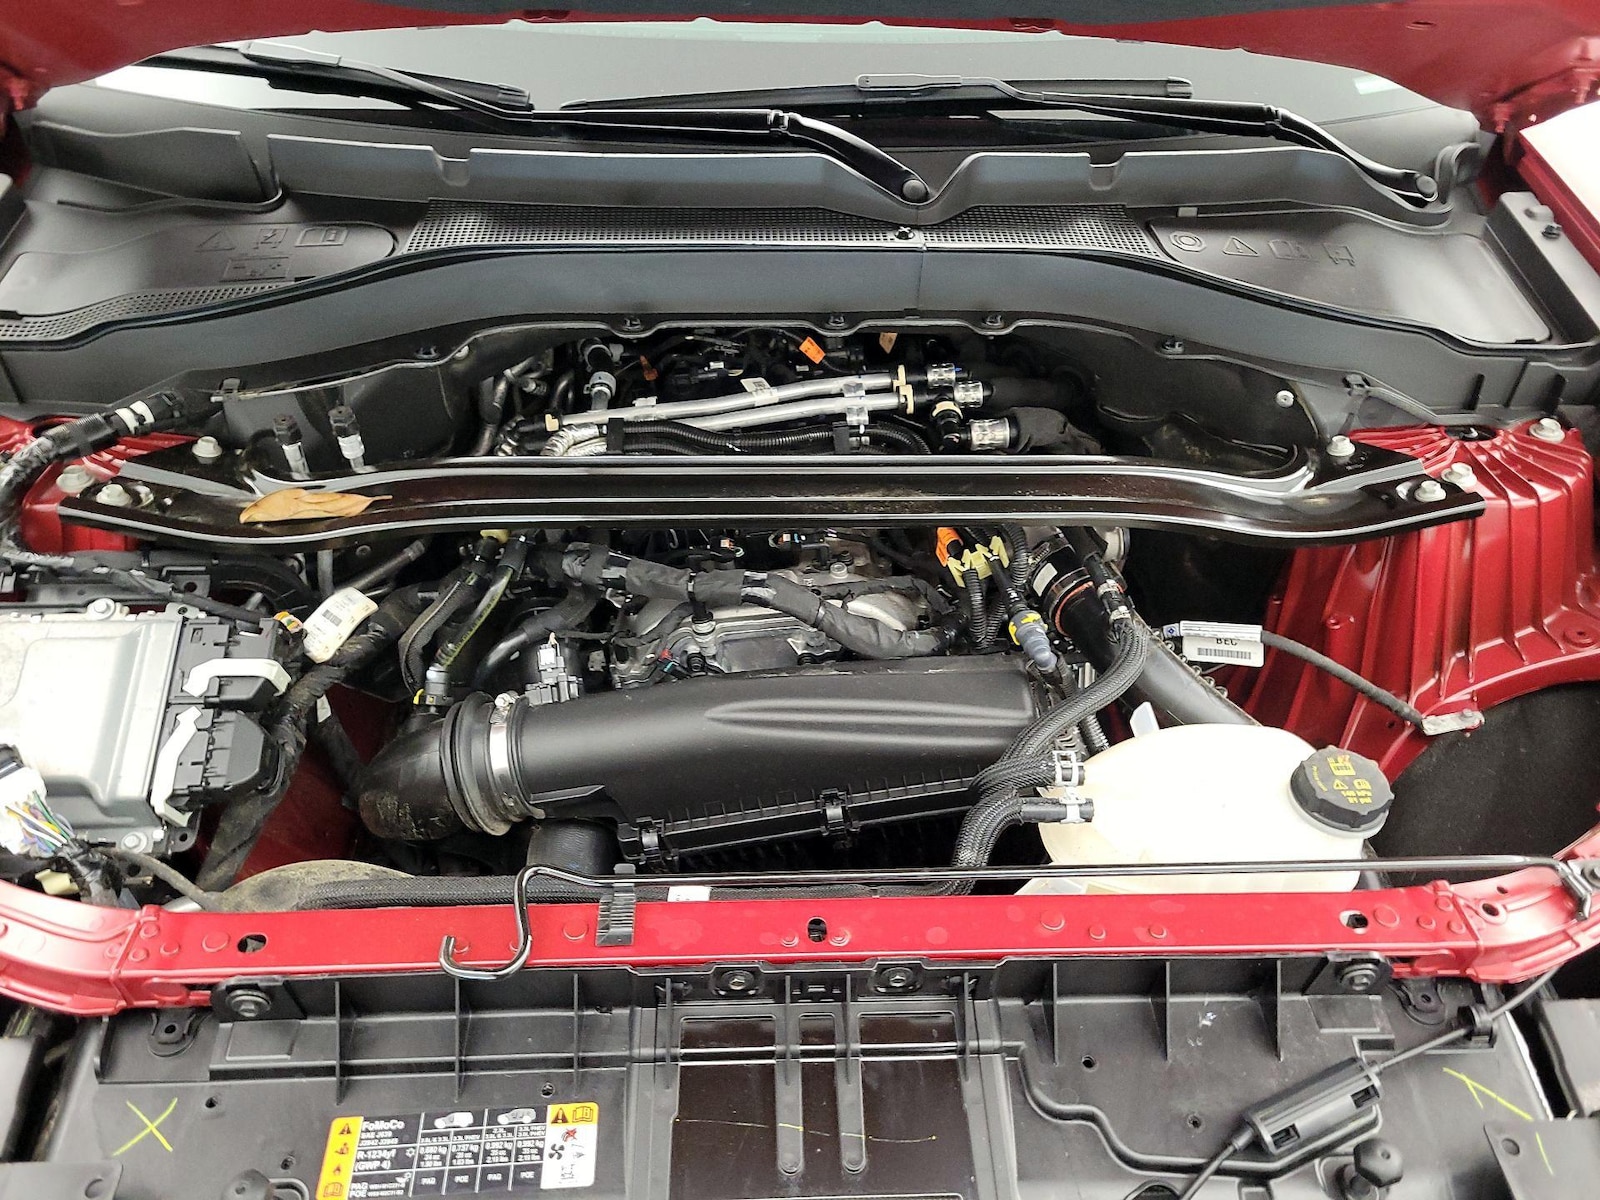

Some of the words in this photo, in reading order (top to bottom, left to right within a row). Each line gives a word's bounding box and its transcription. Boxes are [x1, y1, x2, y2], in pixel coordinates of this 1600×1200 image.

[362, 1120, 405, 1132] FoMoCo
[356, 1148, 397, 1160] R-1234yf
[354, 1160, 380, 1172] (GWP
[381, 1160, 391, 1170] 4)
[454, 1175, 470, 1183] POE
[350, 1182, 368, 1190] PAG
[349, 1190, 367, 1198] POE
